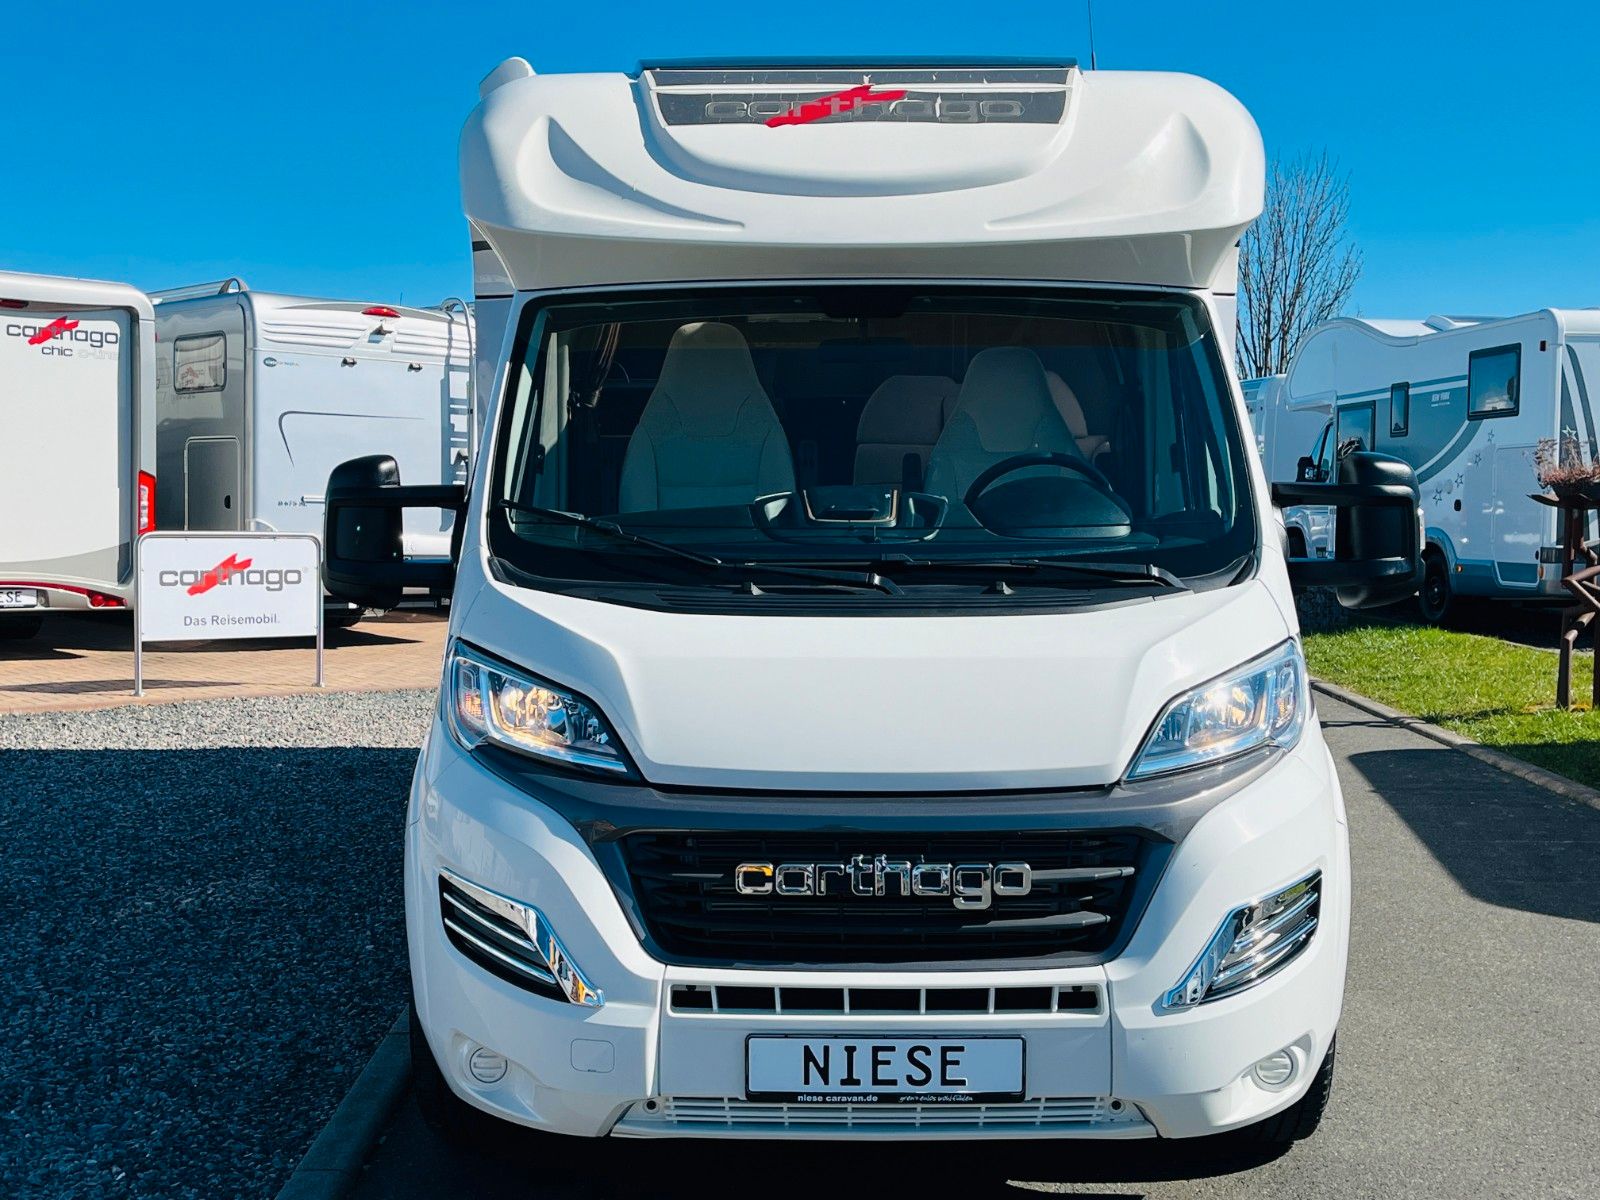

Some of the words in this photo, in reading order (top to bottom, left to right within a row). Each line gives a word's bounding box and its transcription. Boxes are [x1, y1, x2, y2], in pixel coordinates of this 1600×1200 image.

[705, 95, 1025, 122] carthago
[6, 323, 119, 348] carthago
[41, 346, 73, 357] chic
[159, 566, 302, 592] carthago
[183, 615, 207, 626] Das
[211, 613, 280, 625] Reisemobil.
[735, 854, 1032, 911] carthago
[803, 1044, 969, 1087] NIESE
[798, 1094, 824, 1102] niese
[825, 1094, 879, 1102] caravan.de
